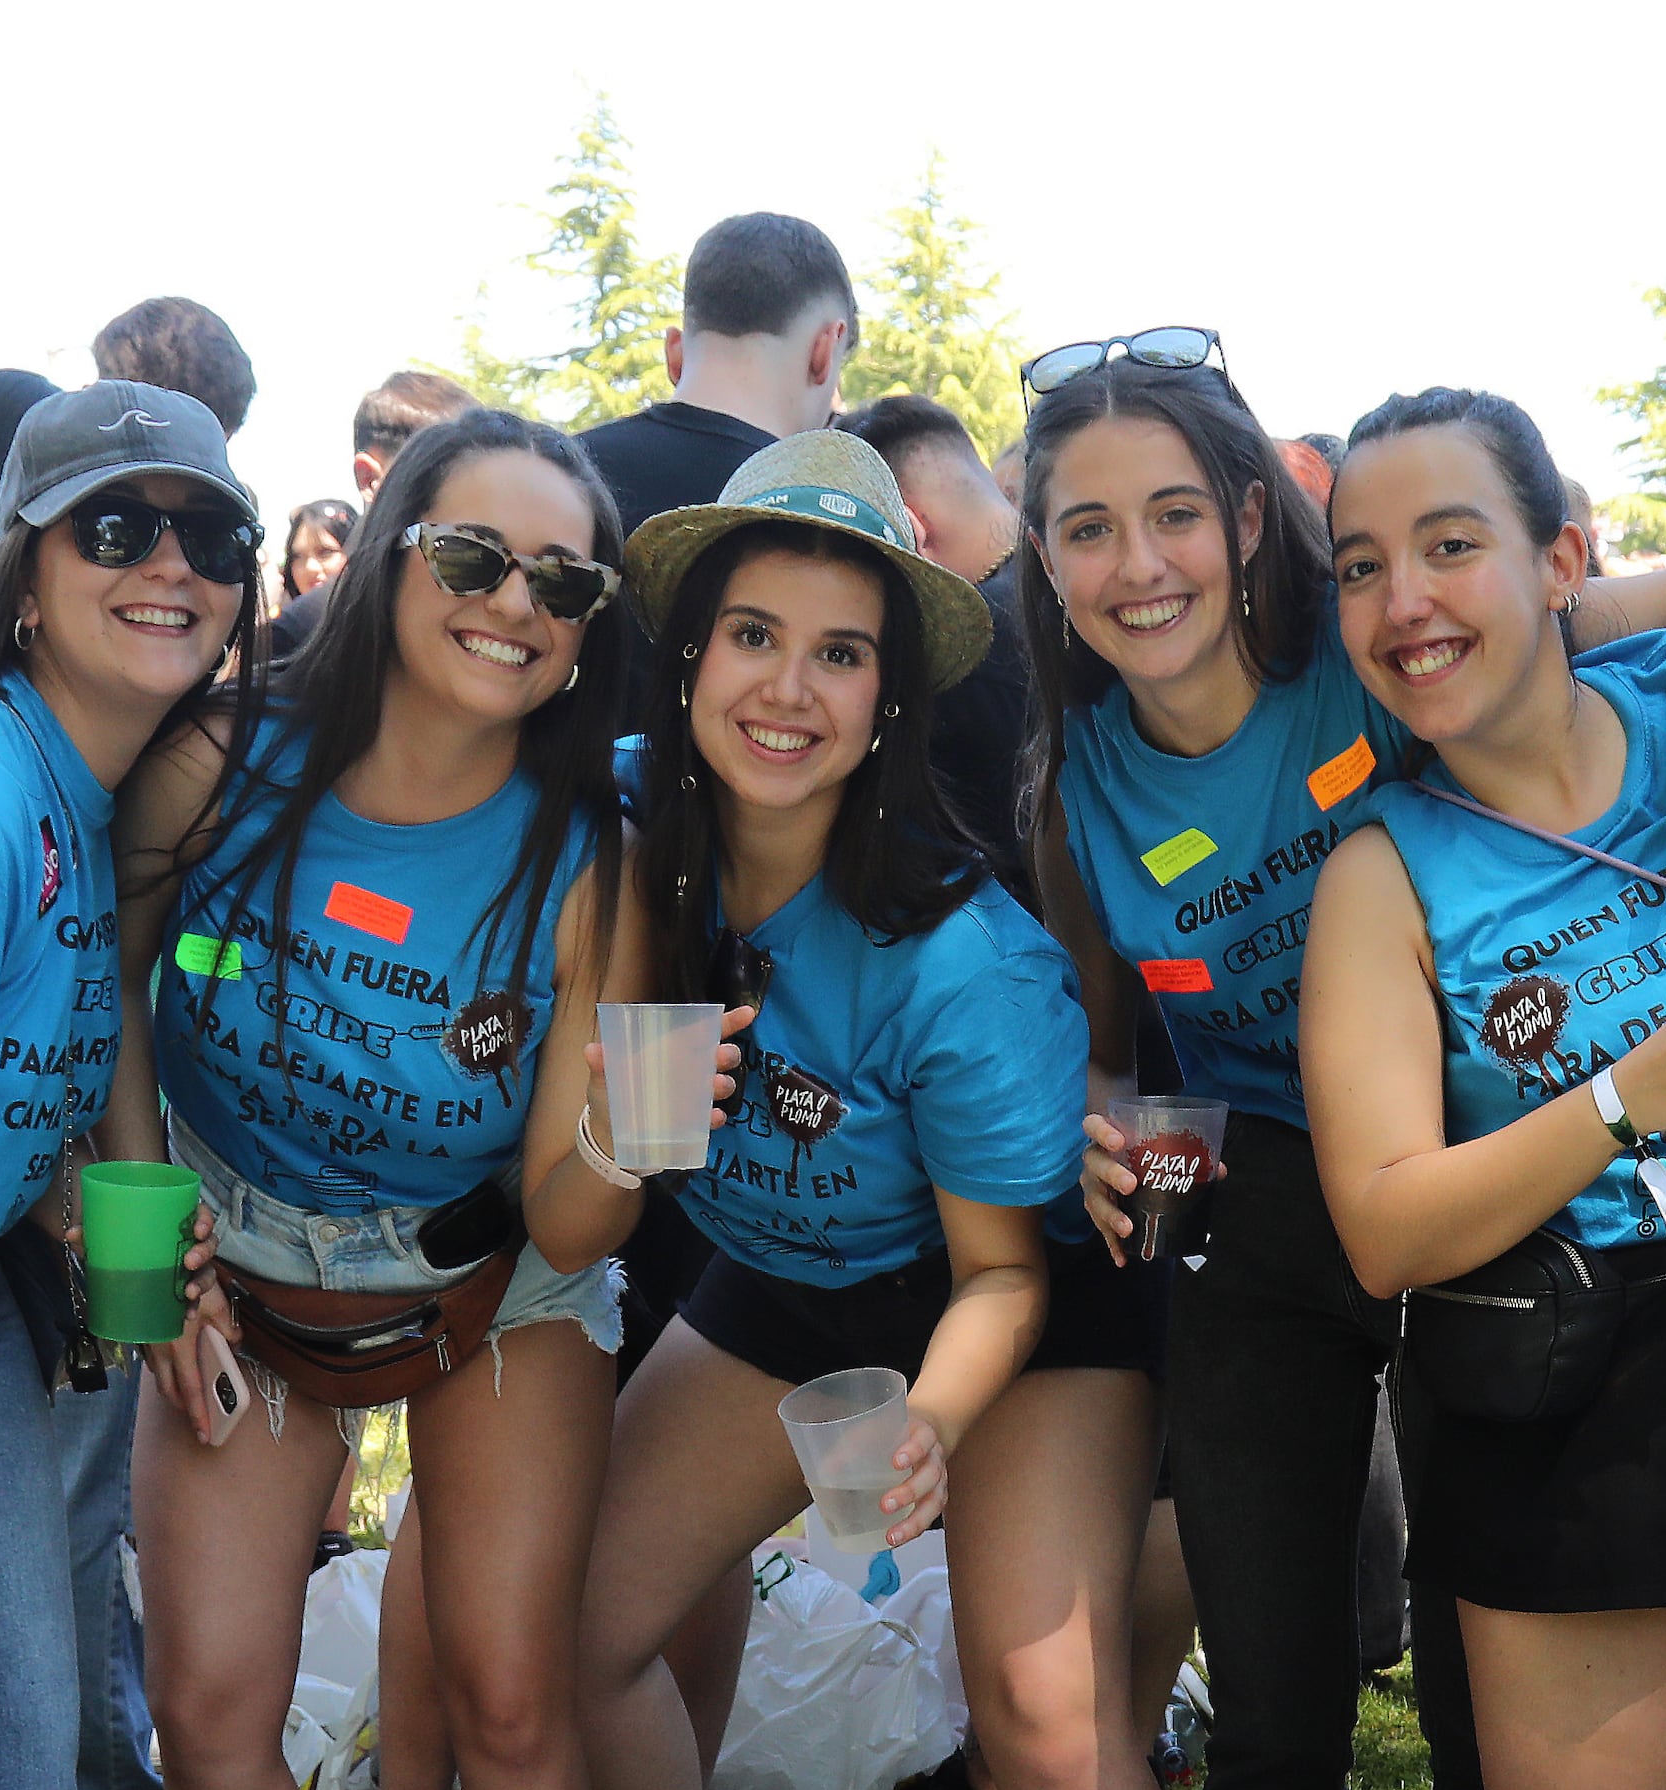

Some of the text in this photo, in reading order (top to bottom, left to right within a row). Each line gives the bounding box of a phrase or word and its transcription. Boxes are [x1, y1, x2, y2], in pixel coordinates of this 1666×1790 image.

[1173, 871, 1265, 935] QUIÉN
[231, 908, 336, 977] QUÉN
[341, 951, 451, 1011] FUERA
[1501, 905, 1620, 974] QUIÉN
[255, 980, 397, 1060] GRIPE
[459, 1013, 504, 1048] PLATA
[1492, 987, 1548, 1038] PLATA O
[1506, 1004, 1554, 1051] PLOMO
[258, 1041, 421, 1124] DEJARTE
[435, 1096, 484, 1128] EN
[775, 1084, 830, 1112] PLATA O
[779, 1103, 823, 1130] PLOMO
[810, 1164, 859, 1200] EN
[1140, 1149, 1201, 1175] PLATA O
[1142, 1169, 1194, 1194] PLOMO
